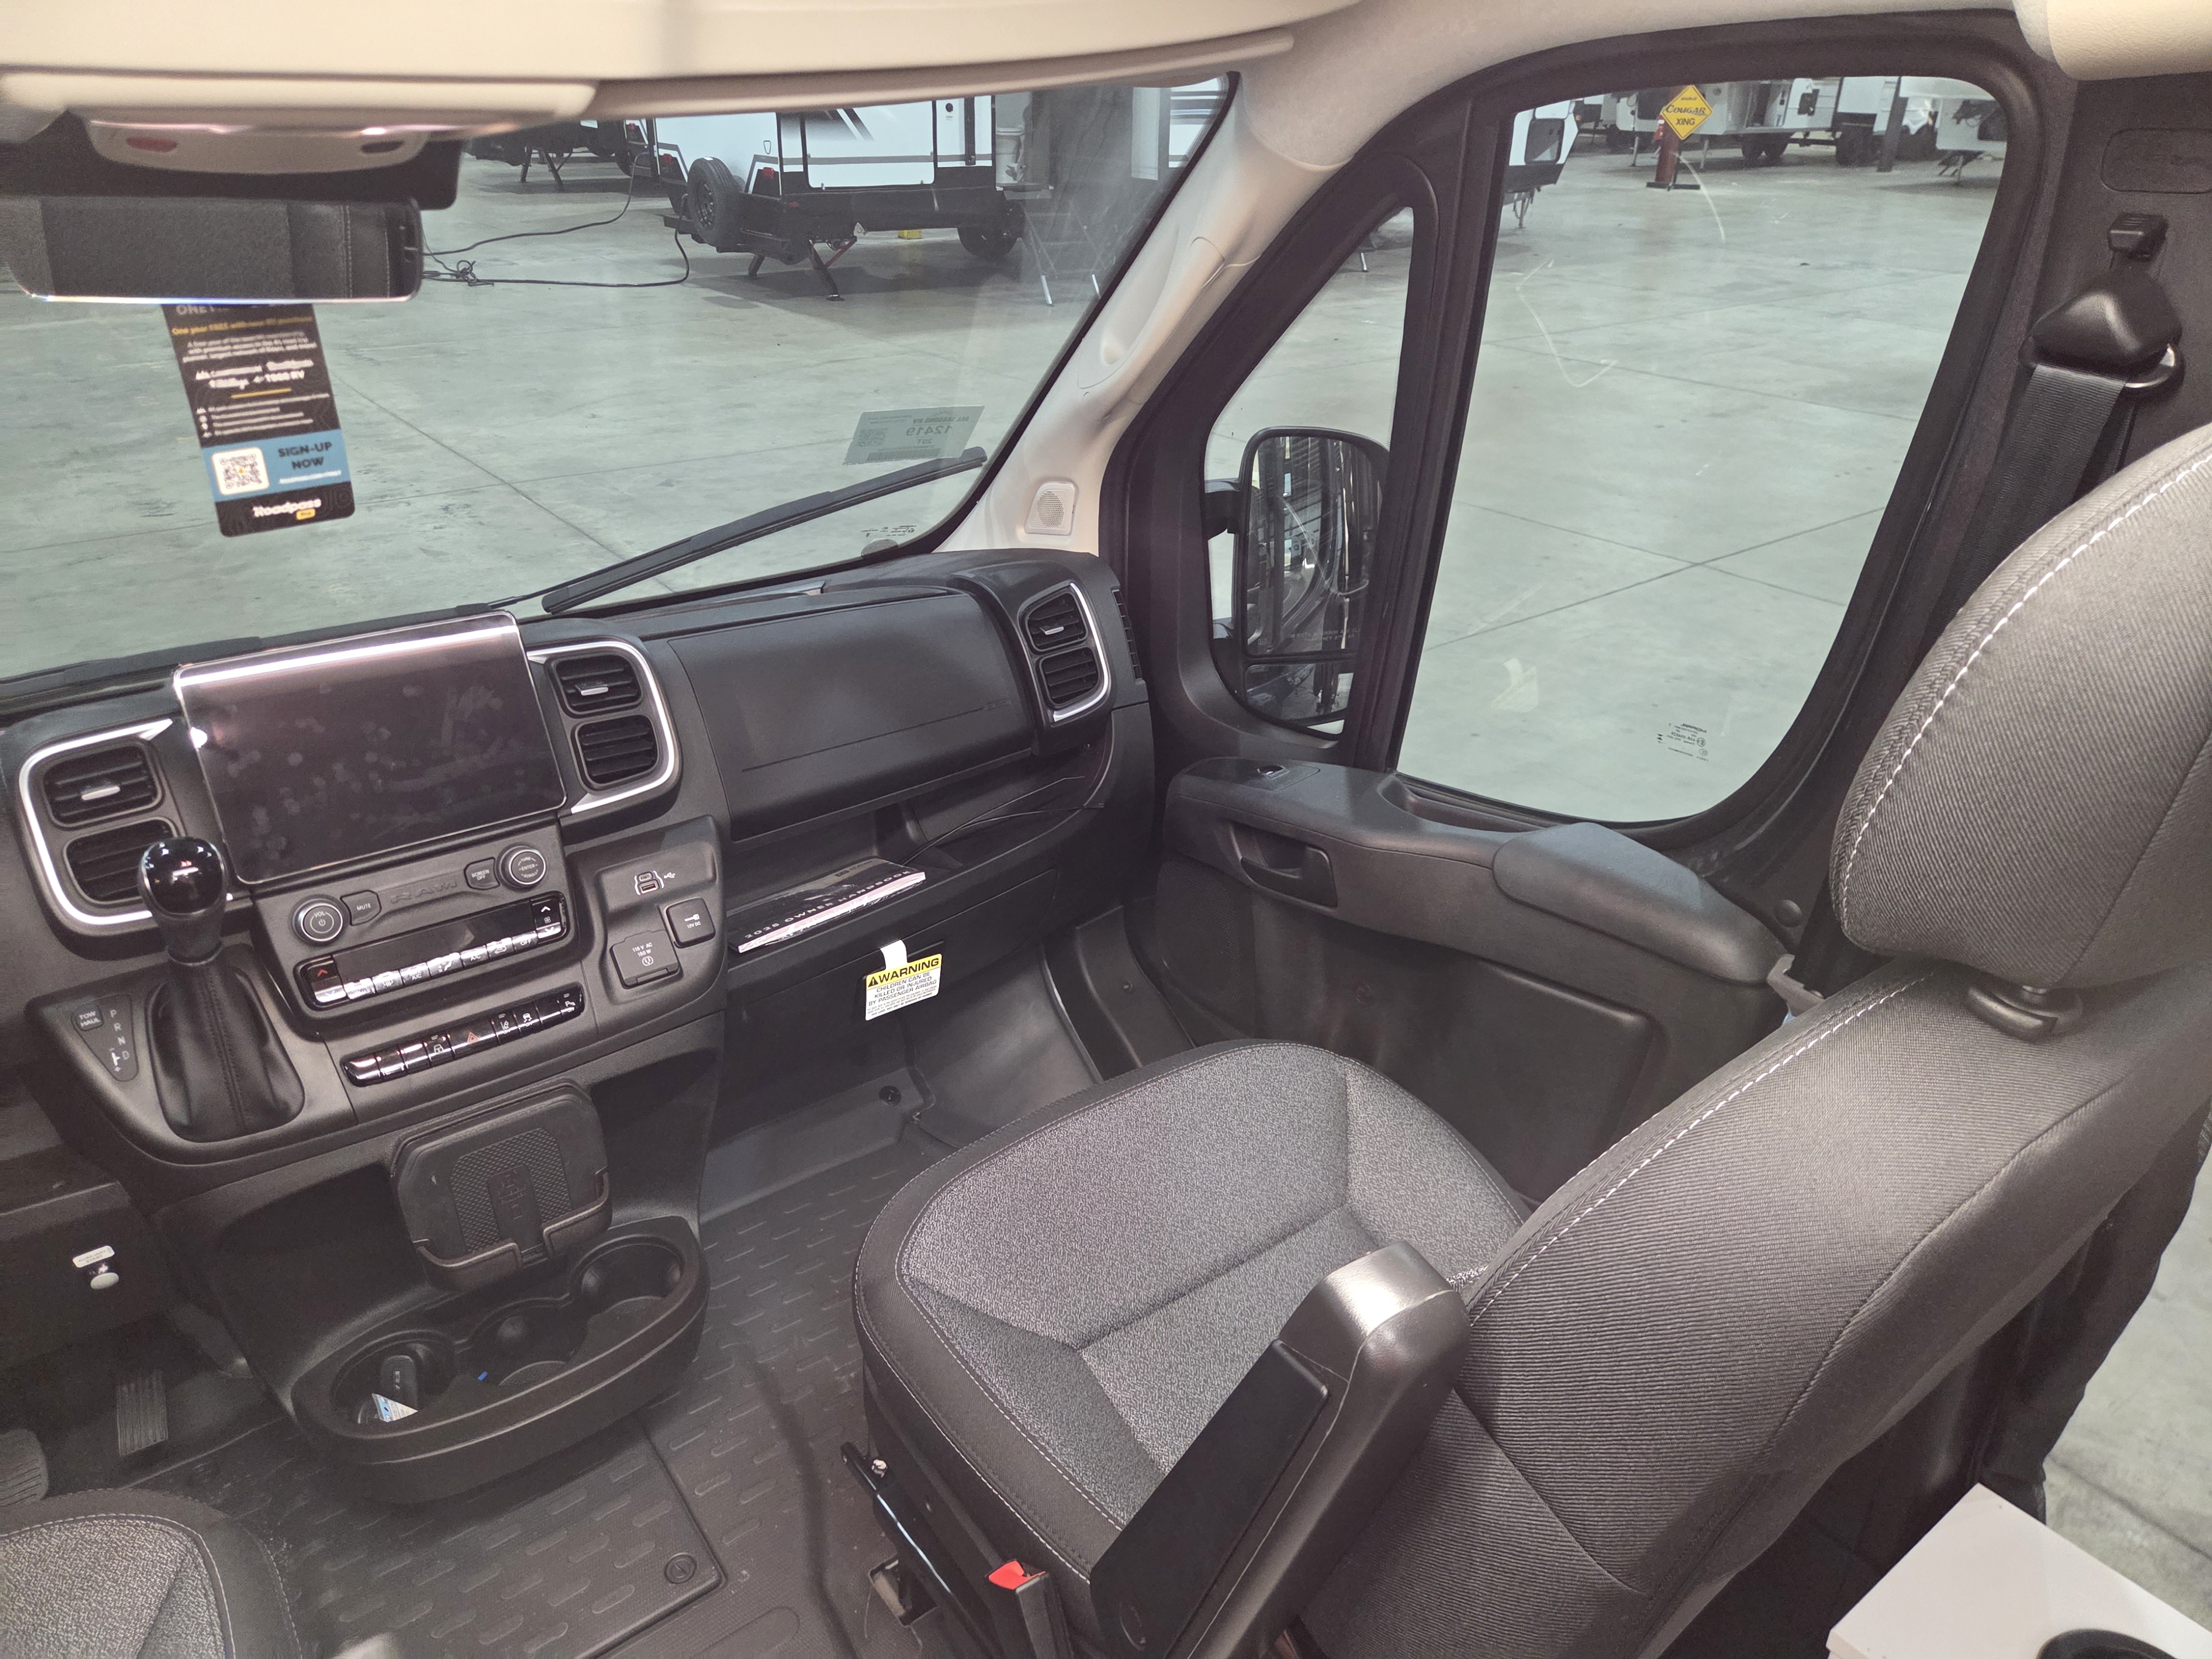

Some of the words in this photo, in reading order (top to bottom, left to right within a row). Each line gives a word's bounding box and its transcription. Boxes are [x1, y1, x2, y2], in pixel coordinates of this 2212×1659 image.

[1666, 105, 1706, 114] COUGAR
[278, 442, 332, 457] SIGN-UP
[291, 457, 324, 469] NOW
[471, 869, 490, 878] SCREEN
[784, 902, 834, 922] OWNER
[838, 870, 911, 902] HANDBOOK
[356, 902, 372, 911] MUTE
[879, 958, 939, 983] WARNING
[874, 988, 895, 998] KILLED
[907, 976, 932, 988] INJURED
[877, 979, 907, 993] CHILDREN
[878, 987, 914, 1003] PASSENGER
[915, 979, 937, 990] AIRBAG
[79, 1011, 96, 1020] TOW
[110, 1009, 117, 1018] P
[80, 1018, 101, 1027] HAUL
[114, 1022, 122, 1032] R
[117, 1036, 126, 1045] N
[122, 1050, 130, 1060] D
